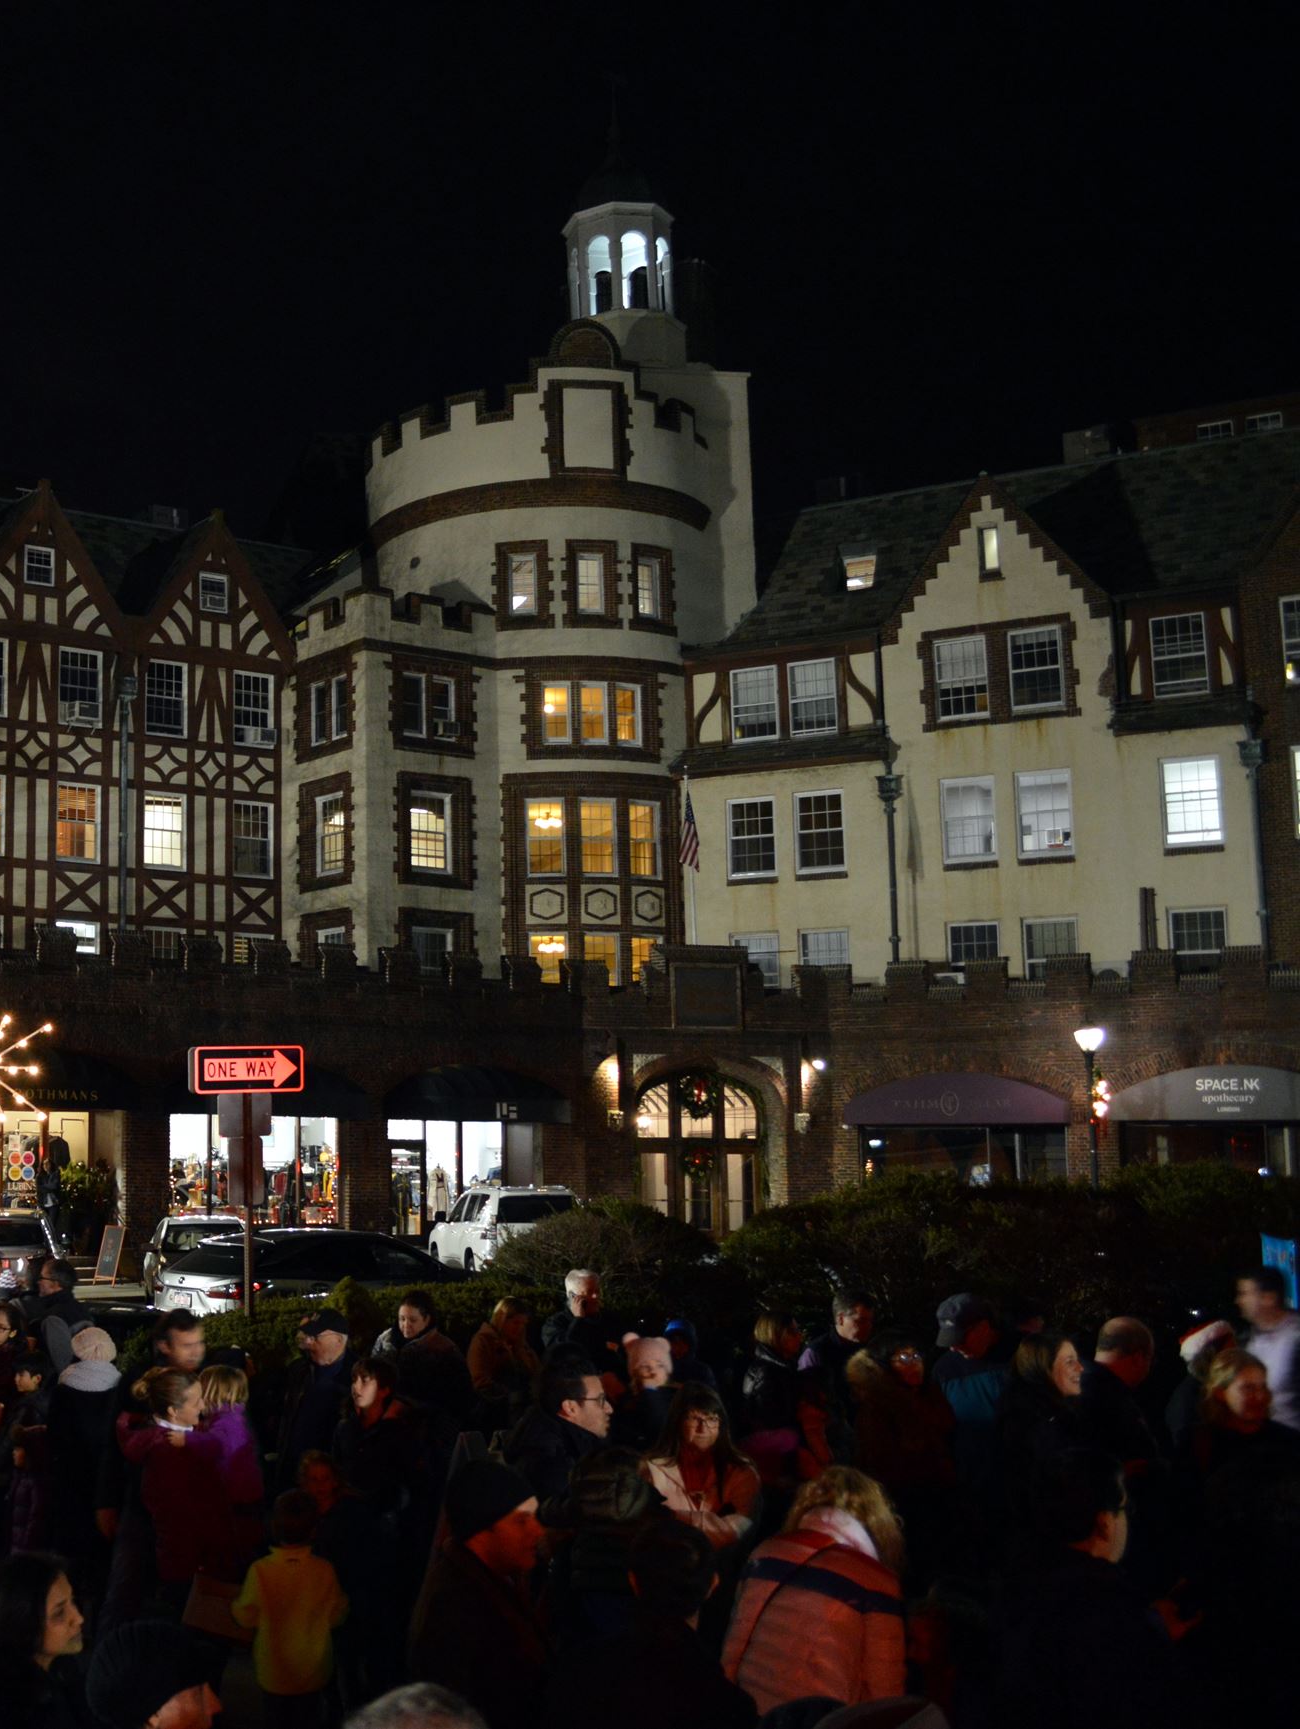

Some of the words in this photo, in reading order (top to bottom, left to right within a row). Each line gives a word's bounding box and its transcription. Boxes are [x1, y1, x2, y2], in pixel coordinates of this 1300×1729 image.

[207, 1061, 237, 1078] ONE
[246, 1060, 277, 1077] WAY
[1195, 1078, 1260, 1091] SPACE.NK
[1201, 1093, 1256, 1104] apothecary
